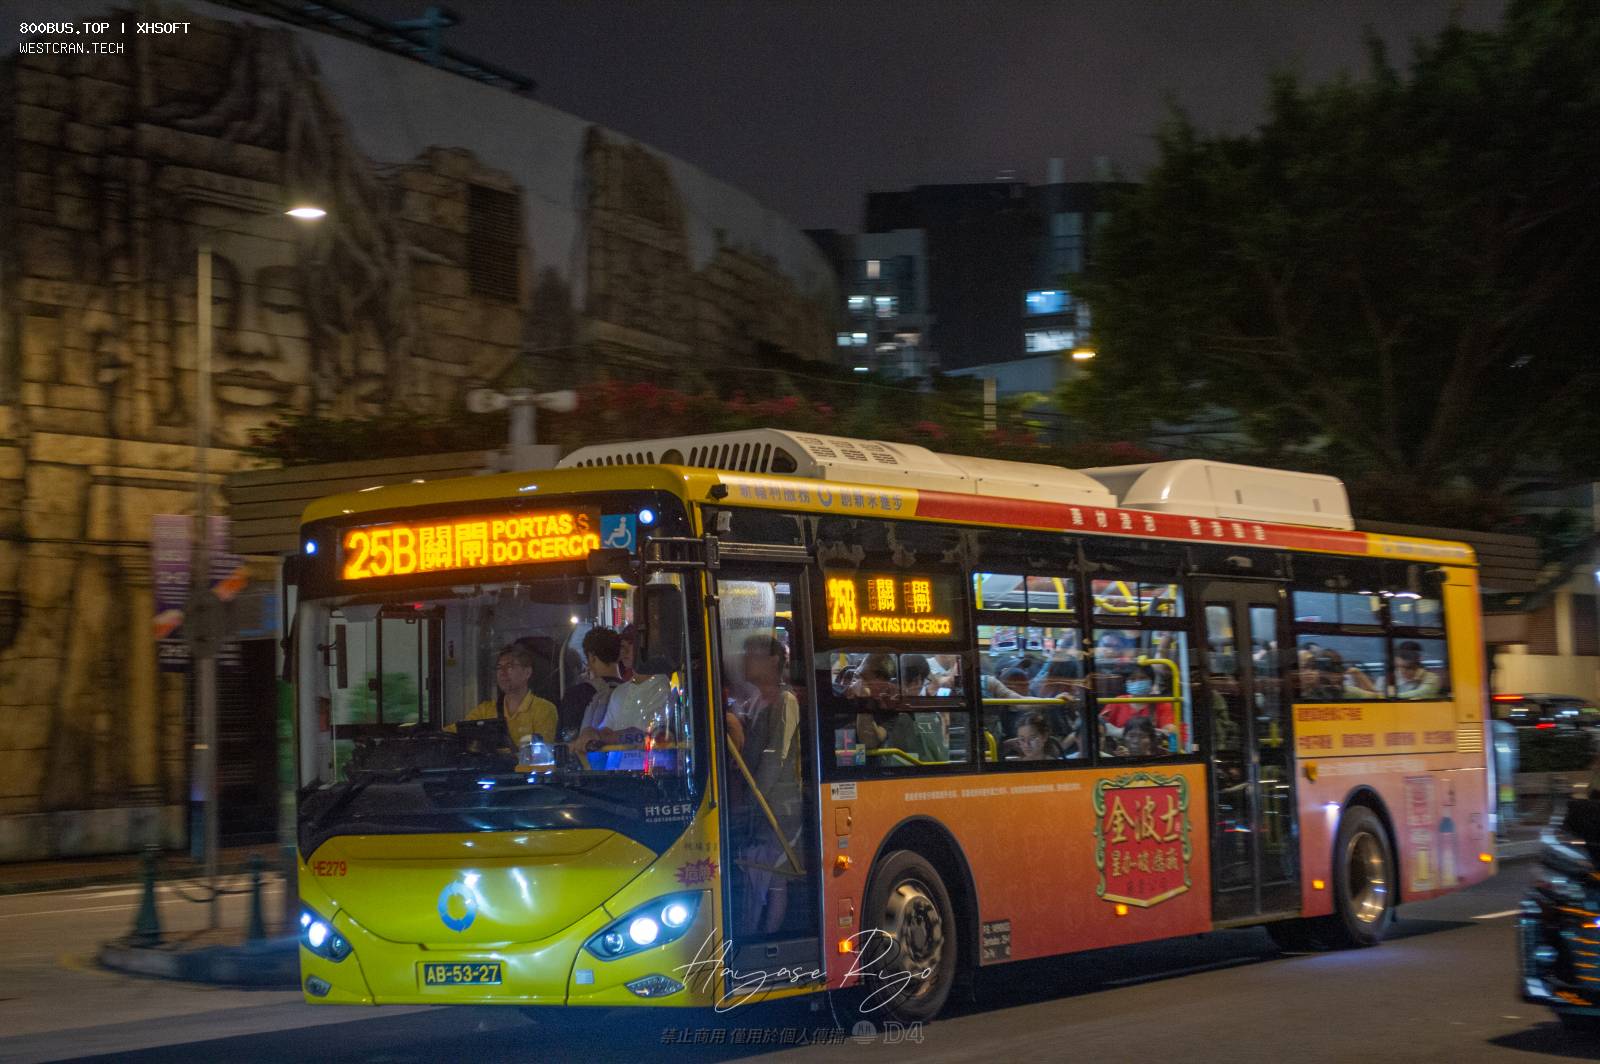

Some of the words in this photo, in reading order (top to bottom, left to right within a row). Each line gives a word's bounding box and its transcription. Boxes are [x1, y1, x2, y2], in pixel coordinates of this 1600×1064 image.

[492, 514, 574, 541] PORTAS
[345, 528, 417, 580] 25B
[493, 541, 524, 562] DO
[527, 534, 600, 560] CERCO
[860, 616, 901, 633] PORTAS
[901, 617, 916, 633] DO
[917, 618, 951, 634] CERCO
[645, 803, 692, 817] HIGER
[313, 861, 348, 877] HE279
[425, 965, 500, 984] AB-53-27
